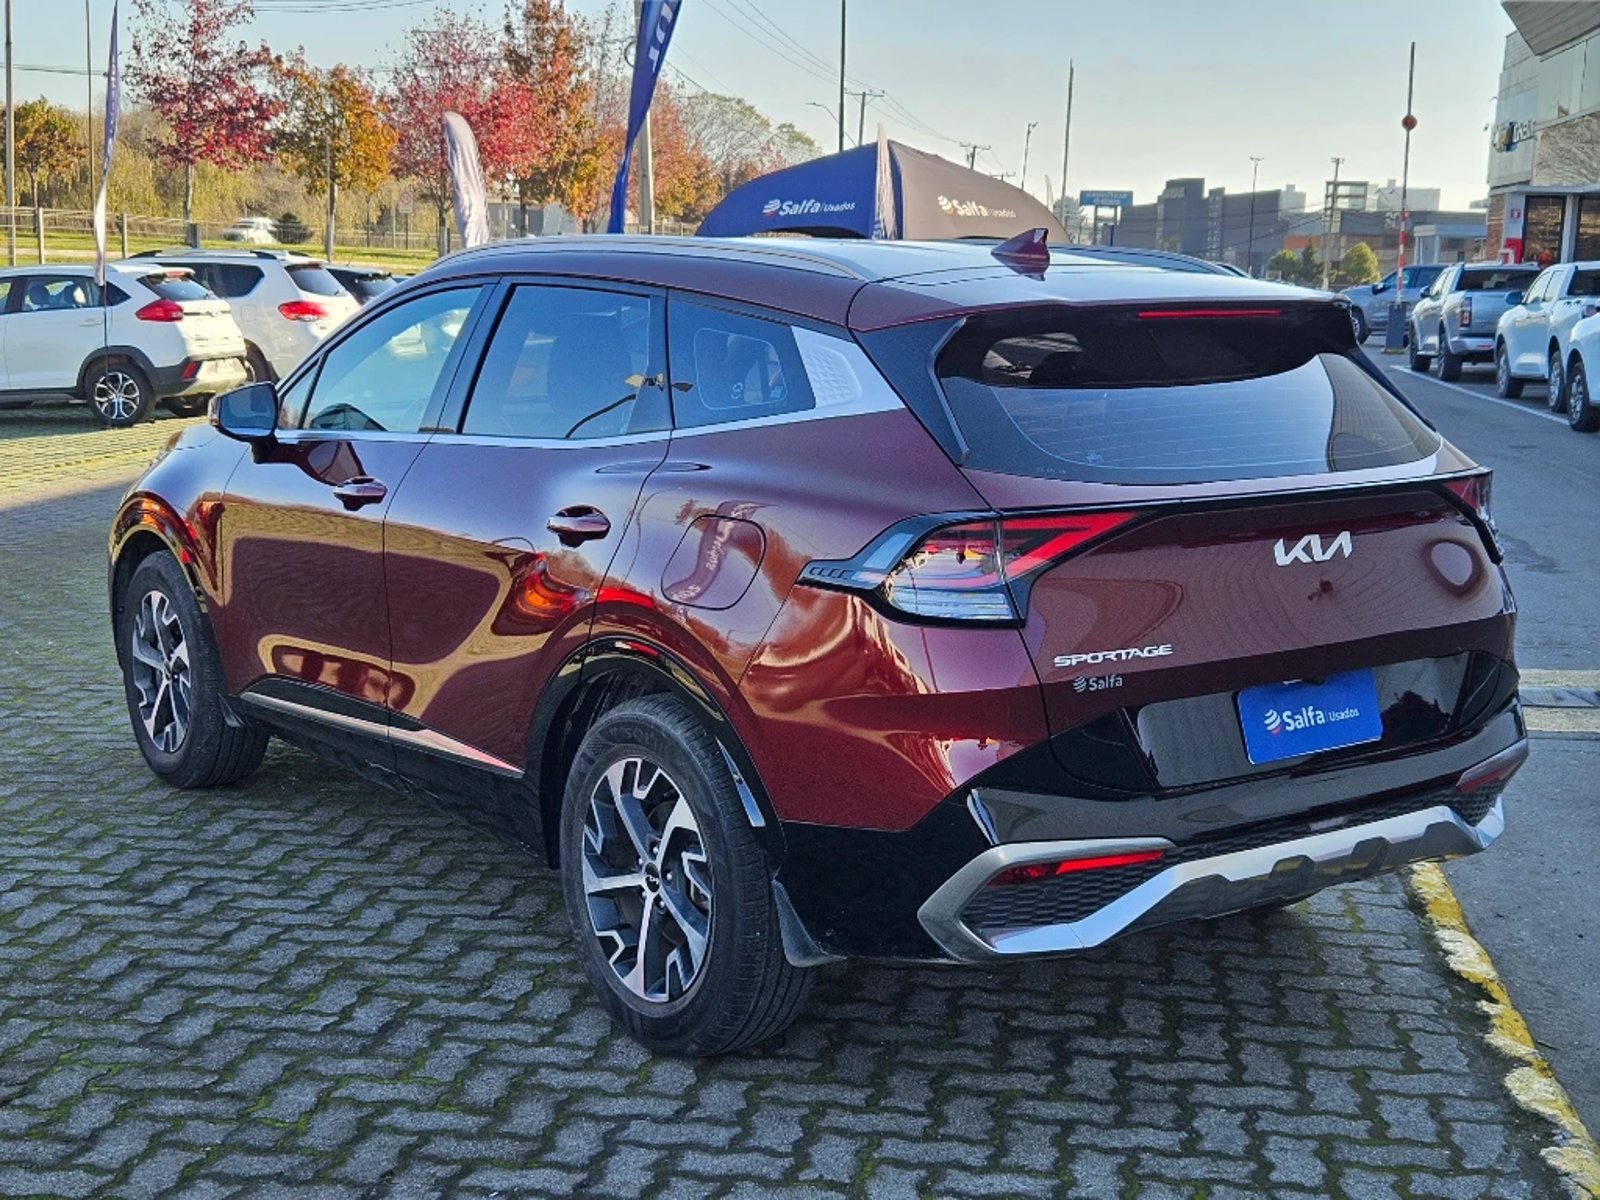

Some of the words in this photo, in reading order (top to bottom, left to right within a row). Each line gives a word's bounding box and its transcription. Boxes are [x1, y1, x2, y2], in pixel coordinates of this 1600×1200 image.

[779, 200, 821, 216] Salfa
[823, 202, 856, 213] Usados
[952, 199, 988, 217] Salfa
[1273, 531, 1352, 567] KIA
[1054, 644, 1174, 667] SPORTAGE
[1088, 674, 1123, 692] Salfa
[1282, 706, 1326, 732] Salfa
[1328, 707, 1360, 722] Usados
